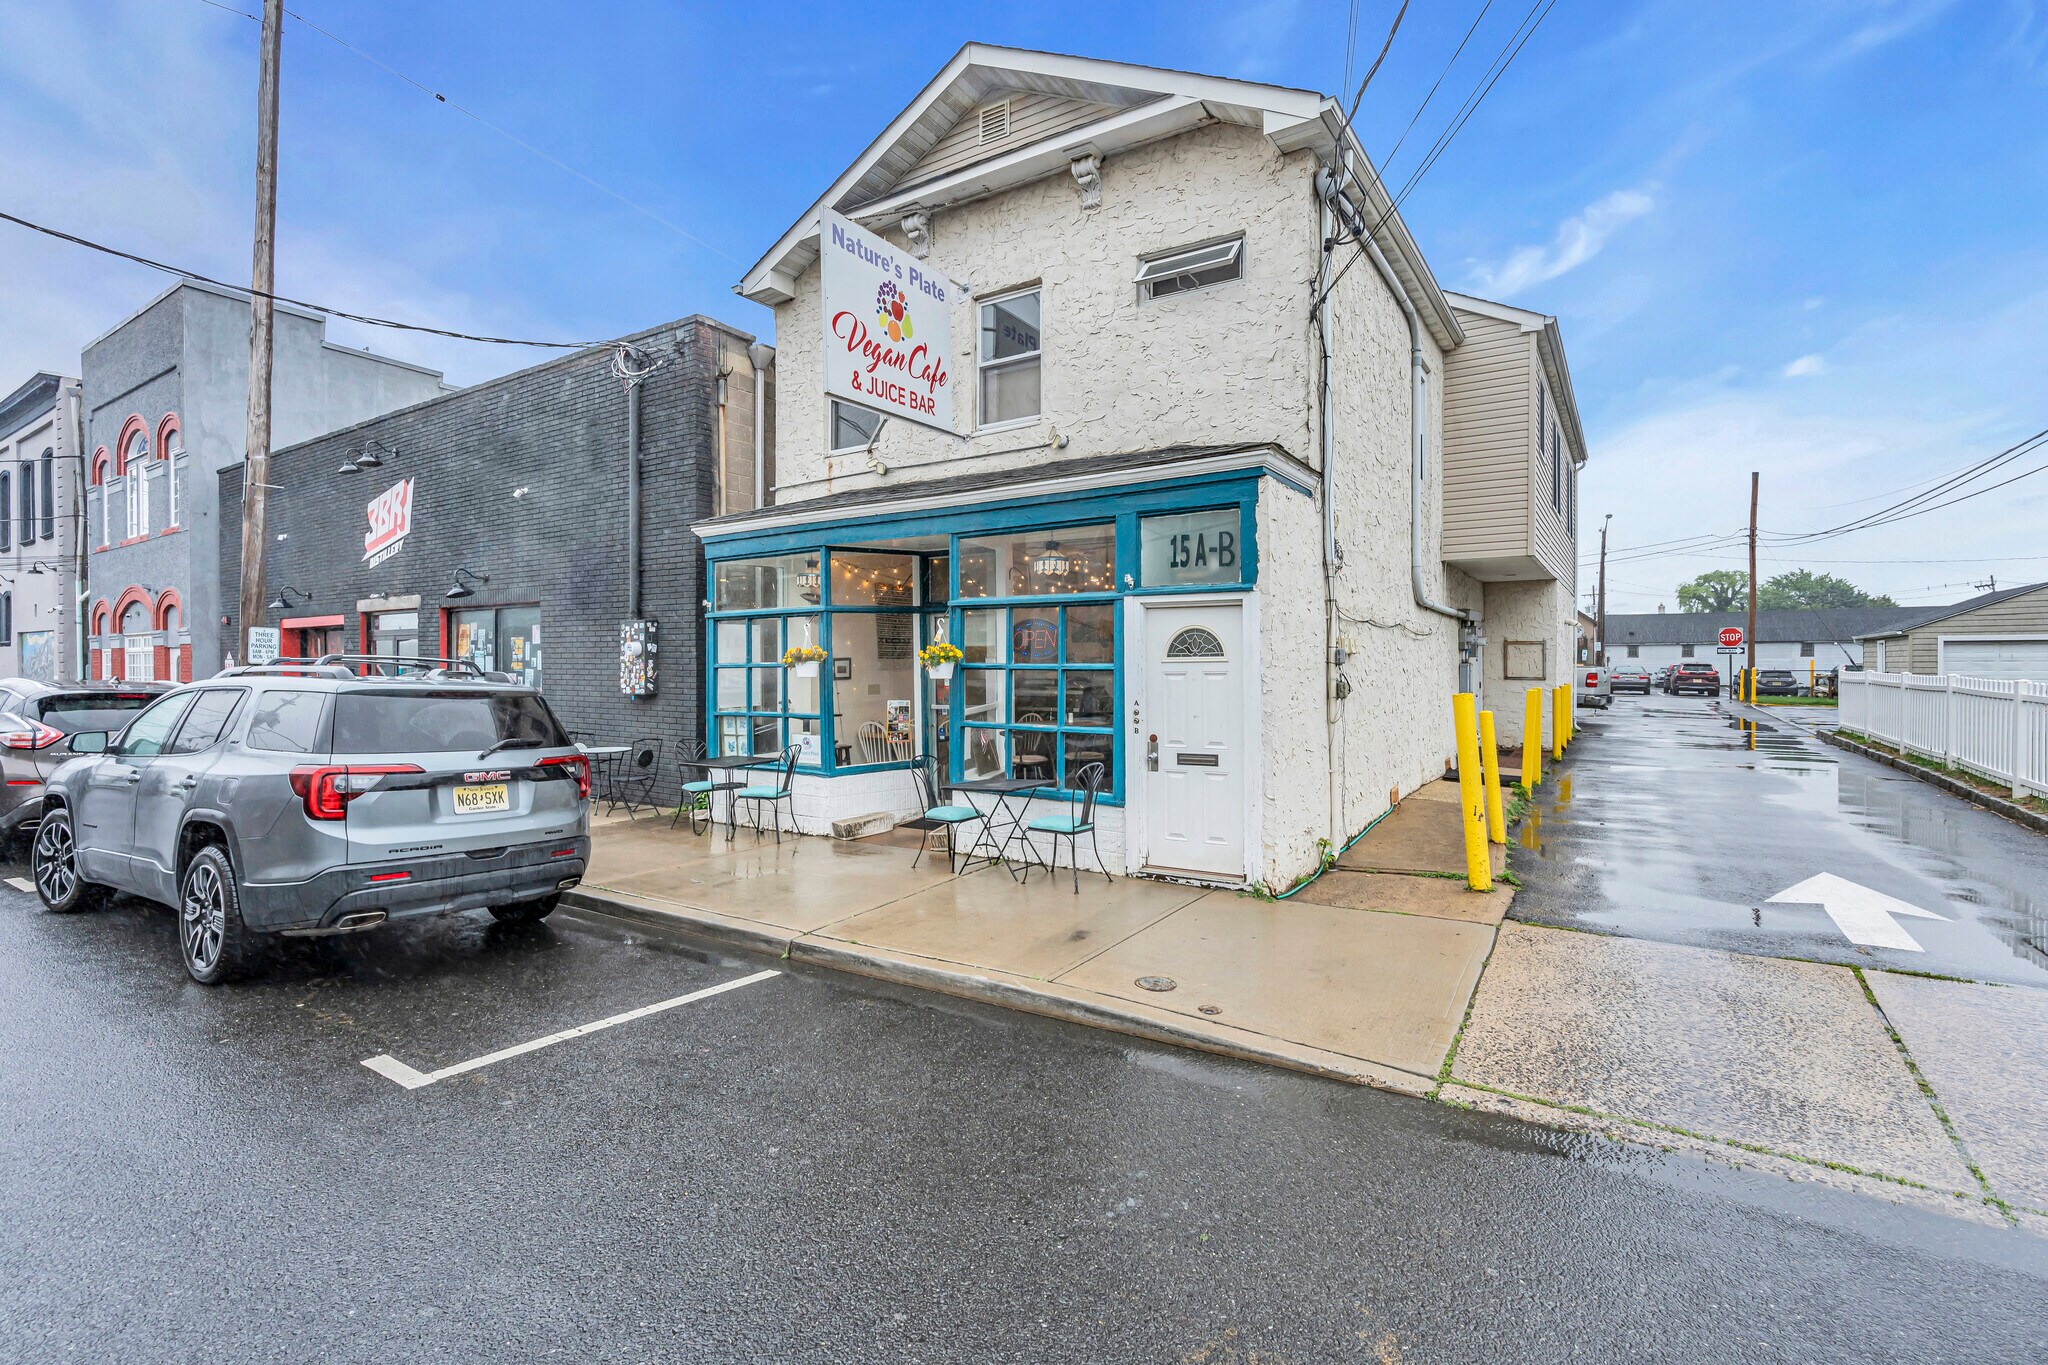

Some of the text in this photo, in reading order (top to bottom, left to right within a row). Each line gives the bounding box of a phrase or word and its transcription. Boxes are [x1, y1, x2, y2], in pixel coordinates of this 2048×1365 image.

[832, 222, 945, 302] Nature's Plate
[832, 311, 948, 394] Vegan Cafe
[851, 370, 936, 416] & JUICE BAR
[369, 539, 405, 570] DISTILLERY
[1013, 629, 1057, 650] OPEN
[1720, 633, 1741, 642] STOP
[464, 770, 511, 782] GMC
[457, 791, 504, 807] N68 SXK
[389, 845, 443, 854] ACADIA
